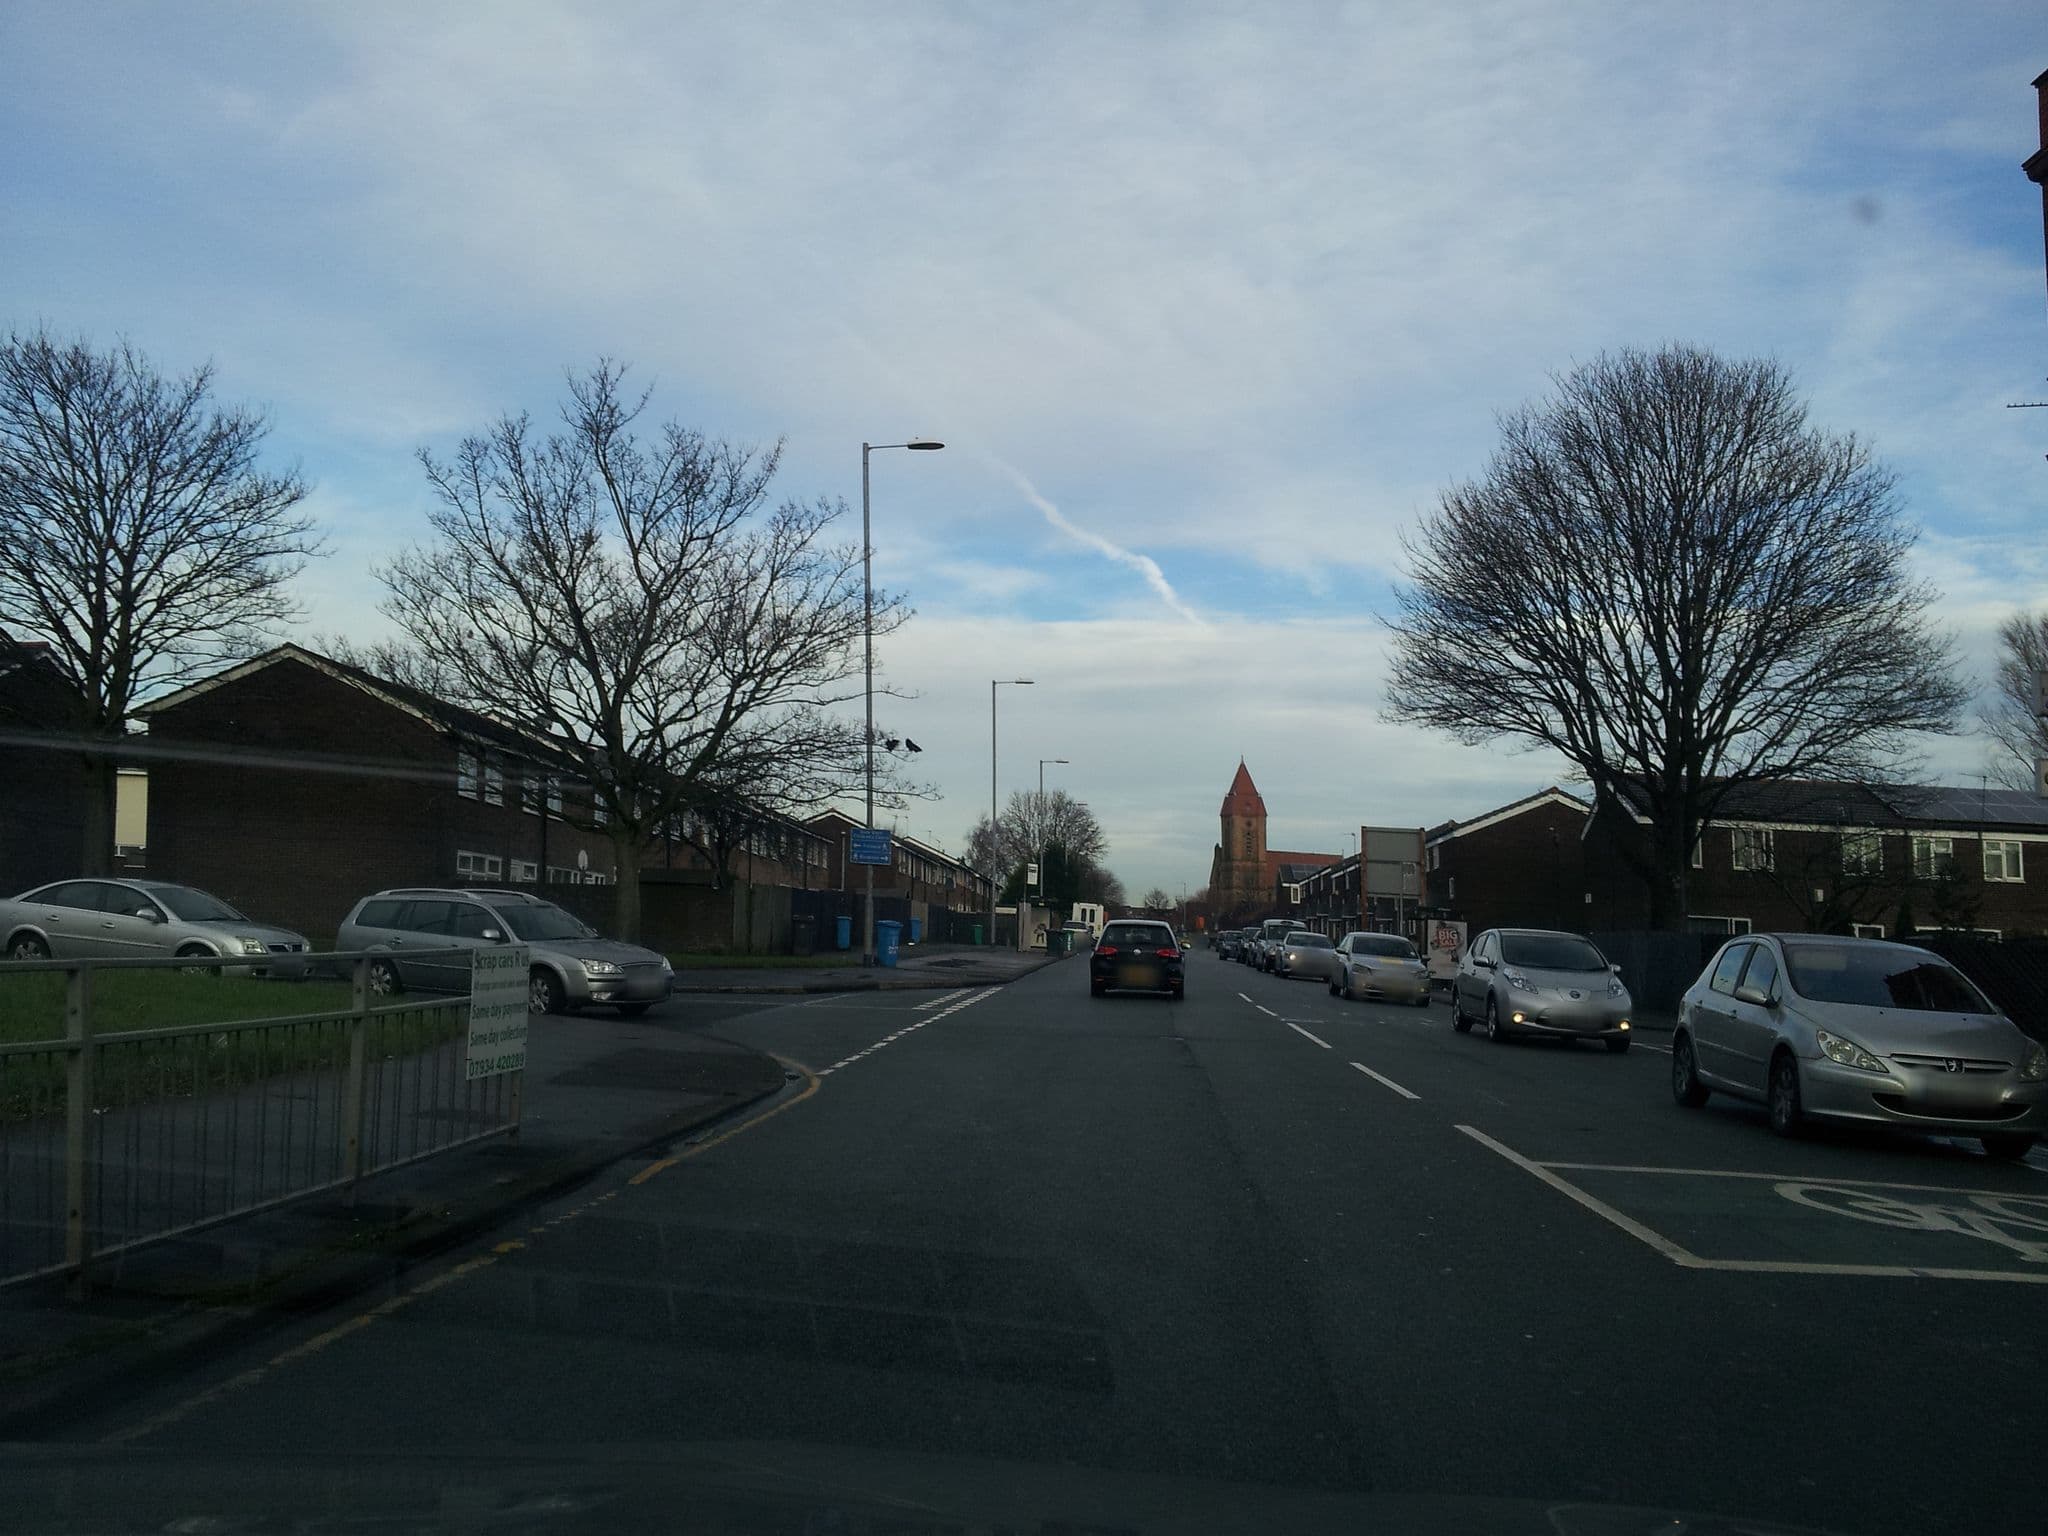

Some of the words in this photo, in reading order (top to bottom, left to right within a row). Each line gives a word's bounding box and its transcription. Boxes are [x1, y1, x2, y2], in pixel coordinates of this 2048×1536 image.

[1438, 930, 1458, 940] BIG
[475, 951, 496, 973] Scrap
[498, 955, 514, 969] cars
[515, 950, 521, 968] R
[472, 1004, 489, 1020] Same
[470, 1031, 487, 1047] Same
[488, 1028, 499, 1047] day
